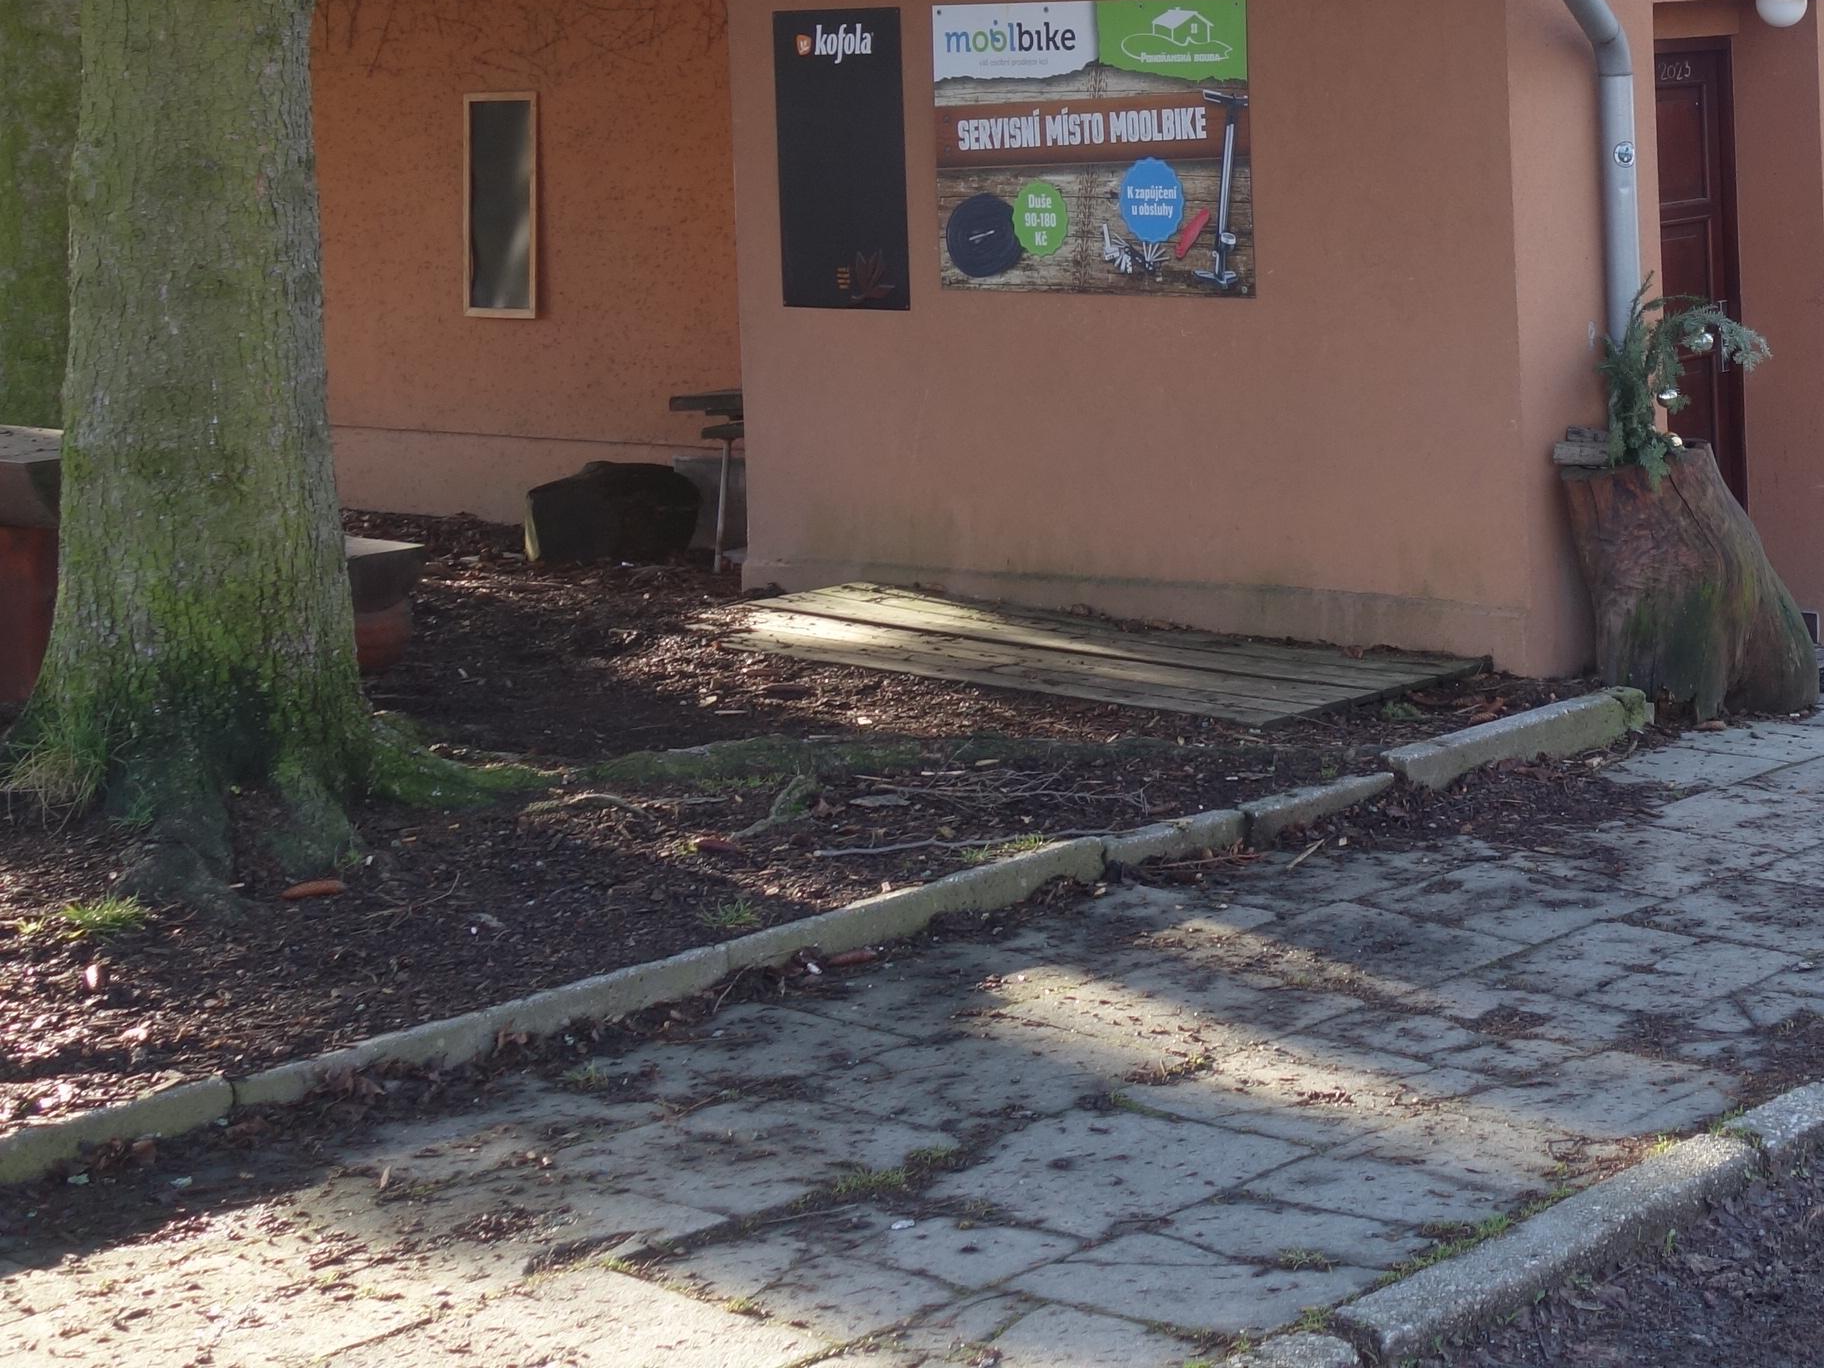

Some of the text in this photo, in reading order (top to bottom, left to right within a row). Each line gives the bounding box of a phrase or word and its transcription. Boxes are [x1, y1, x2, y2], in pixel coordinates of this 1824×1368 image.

[814, 23, 873, 65] kofola
[957, 106, 1208, 151] SERVISNÍ MÍSTO MOOLBIKE
[1027, 193, 1052, 208] Duše
[1127, 185, 1177, 201] K zapůjčení
[1131, 202, 1173, 219] u obsluhy
[1024, 212, 1057, 227] 90-180
[1034, 230, 1048, 246] Kč
